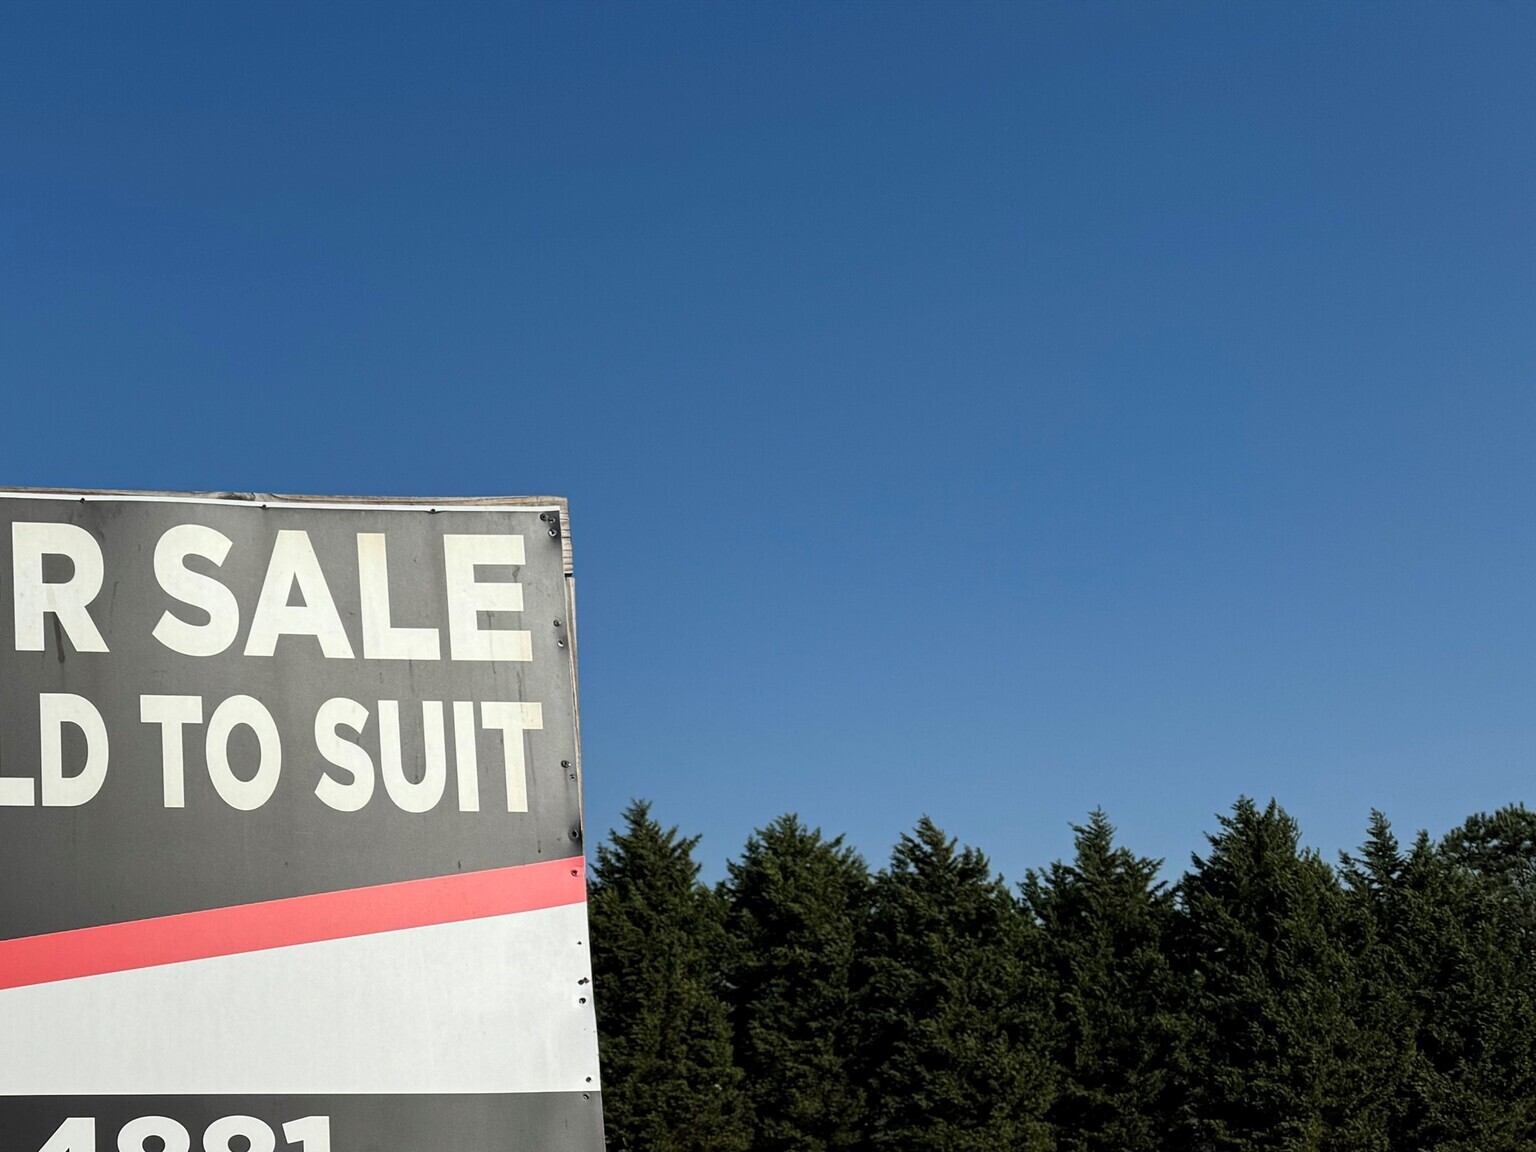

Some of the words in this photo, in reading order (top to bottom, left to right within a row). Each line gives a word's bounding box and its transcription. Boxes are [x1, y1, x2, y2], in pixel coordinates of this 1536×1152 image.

[152, 523, 533, 662] SALE
[140, 694, 282, 811] TO
[314, 697, 543, 813] SUIT
